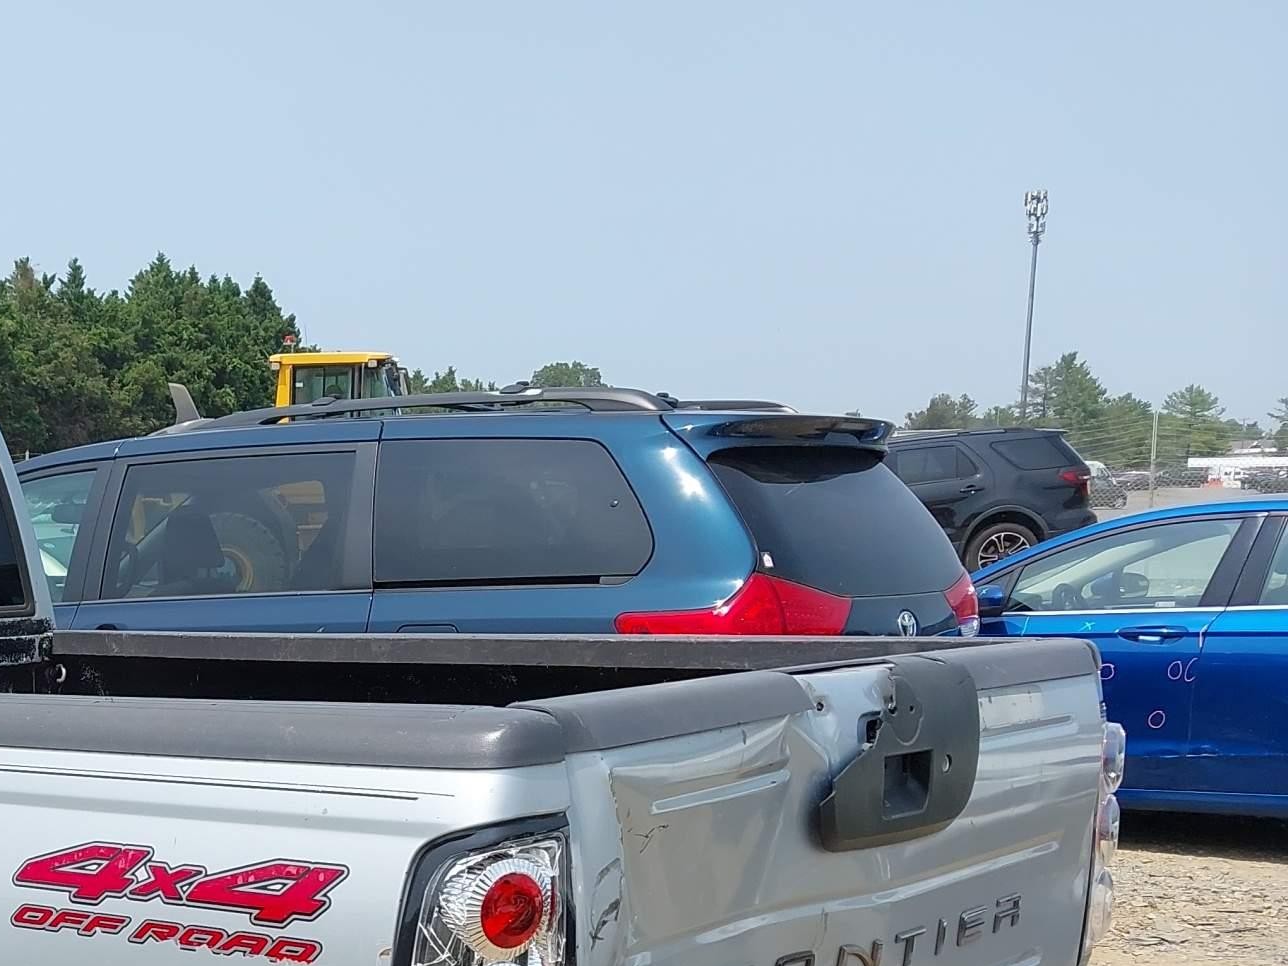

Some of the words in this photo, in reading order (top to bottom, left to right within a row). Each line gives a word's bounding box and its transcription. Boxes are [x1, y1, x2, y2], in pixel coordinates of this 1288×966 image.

[11, 841, 350, 927] 4x4
[11, 903, 132, 936] OFF
[128, 919, 323, 966] ROAD
